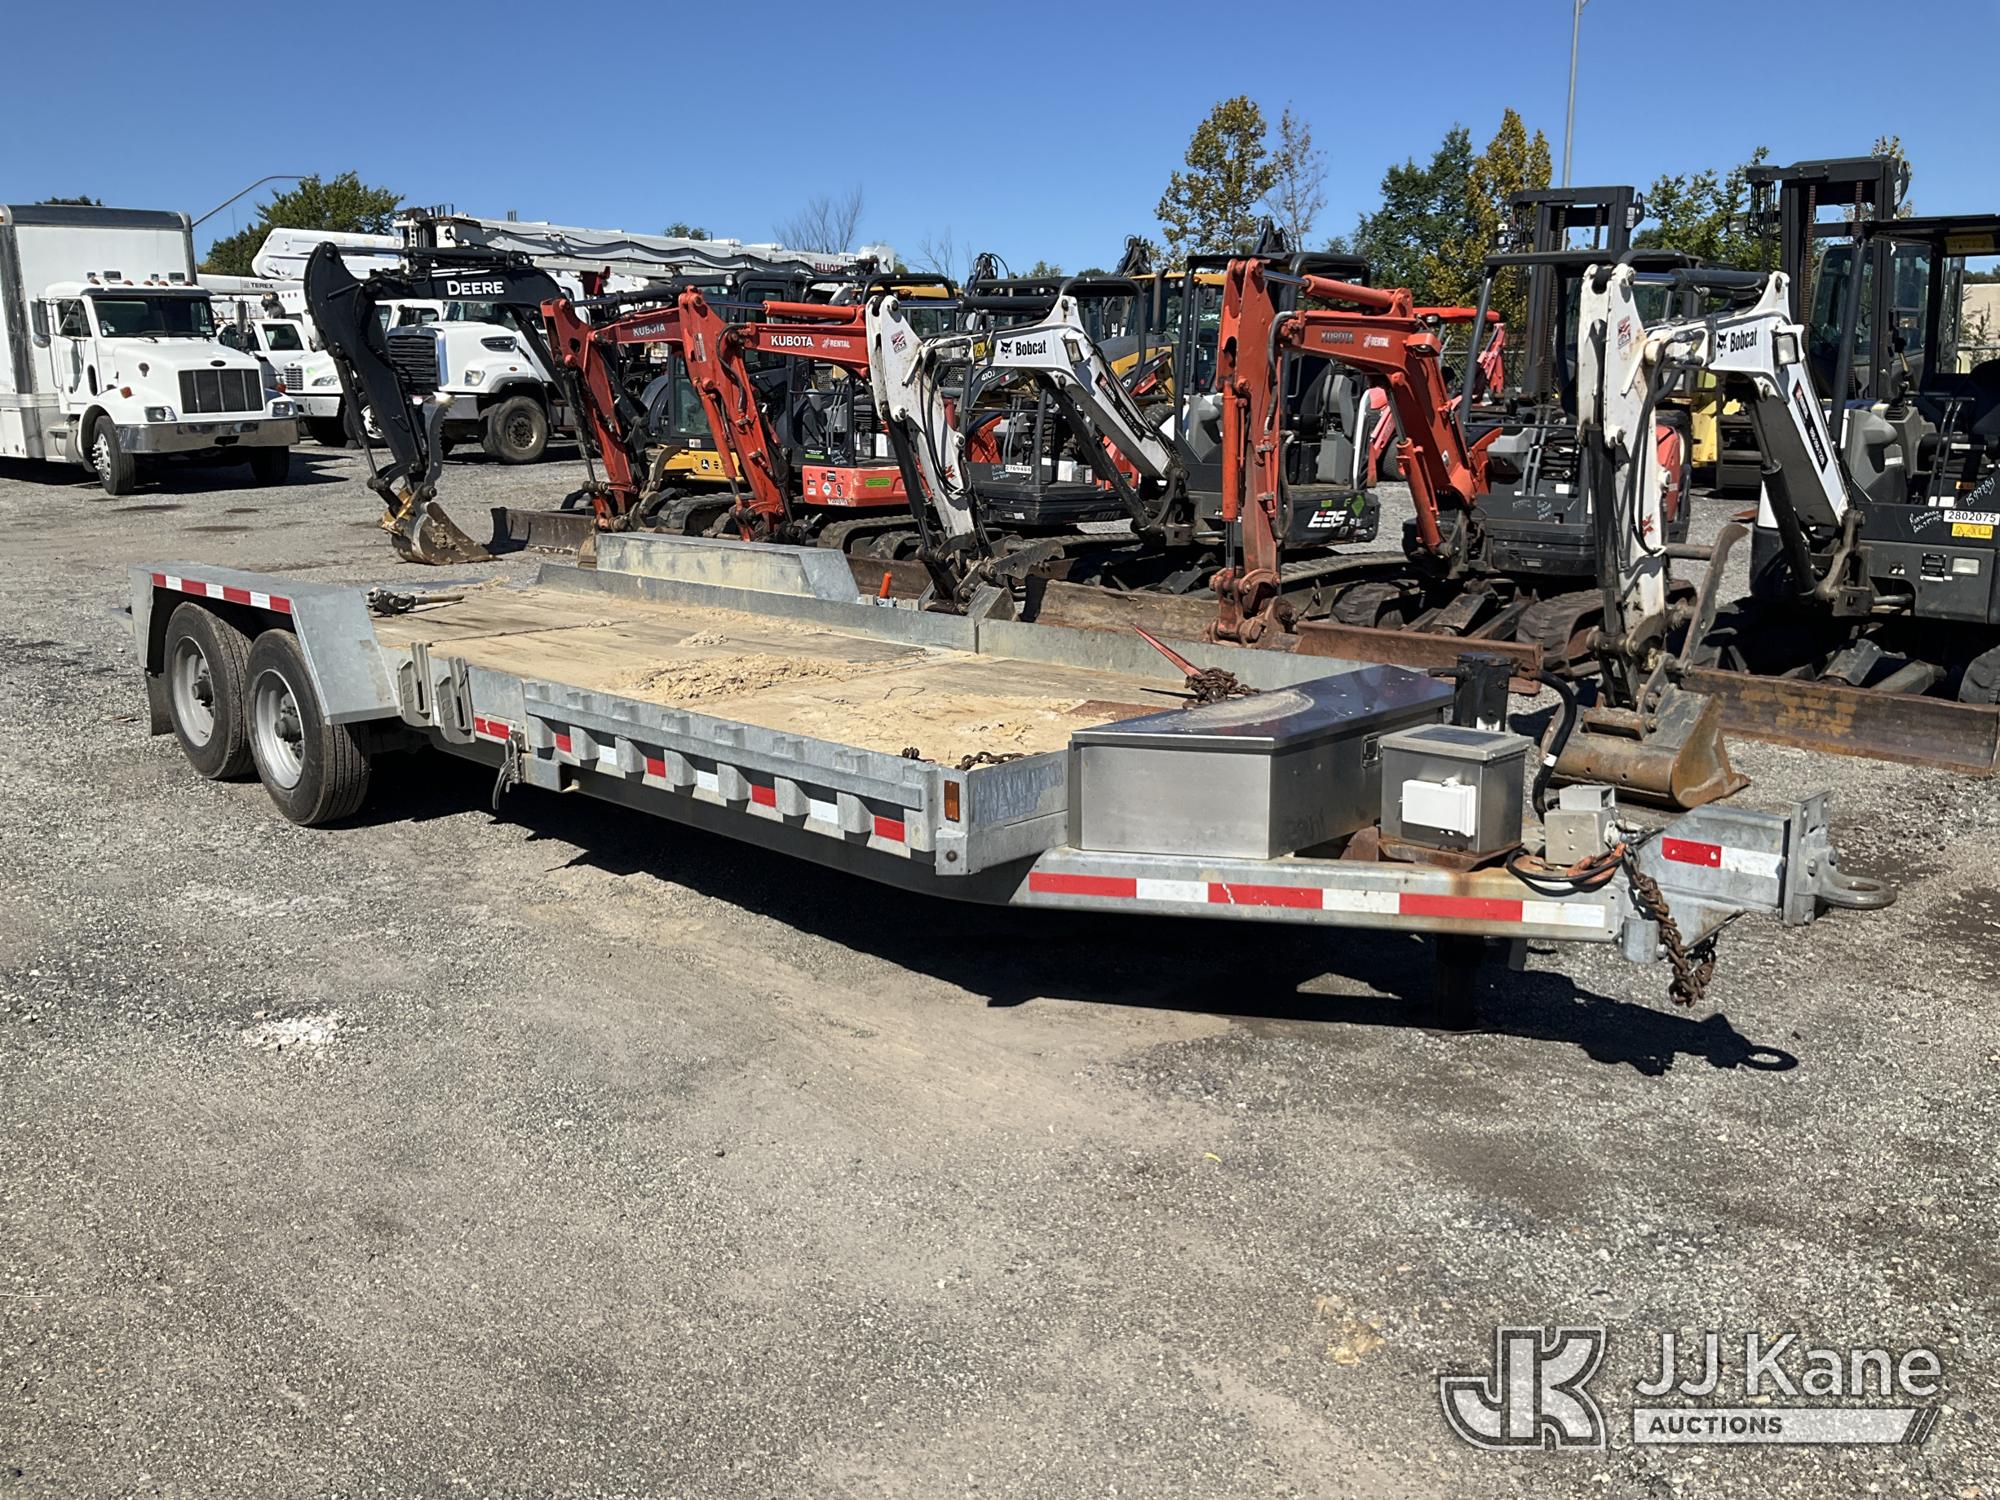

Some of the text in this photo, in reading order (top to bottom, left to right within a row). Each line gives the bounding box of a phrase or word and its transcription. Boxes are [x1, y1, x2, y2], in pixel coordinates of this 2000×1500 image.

[446, 280, 505, 296] DEERE
[771, 335, 814, 347] KUBOTA
[1729, 327, 1758, 352] Bobcat
[1015, 340, 1047, 357] Bobcat
[1948, 510, 1997, 523] 2802075
